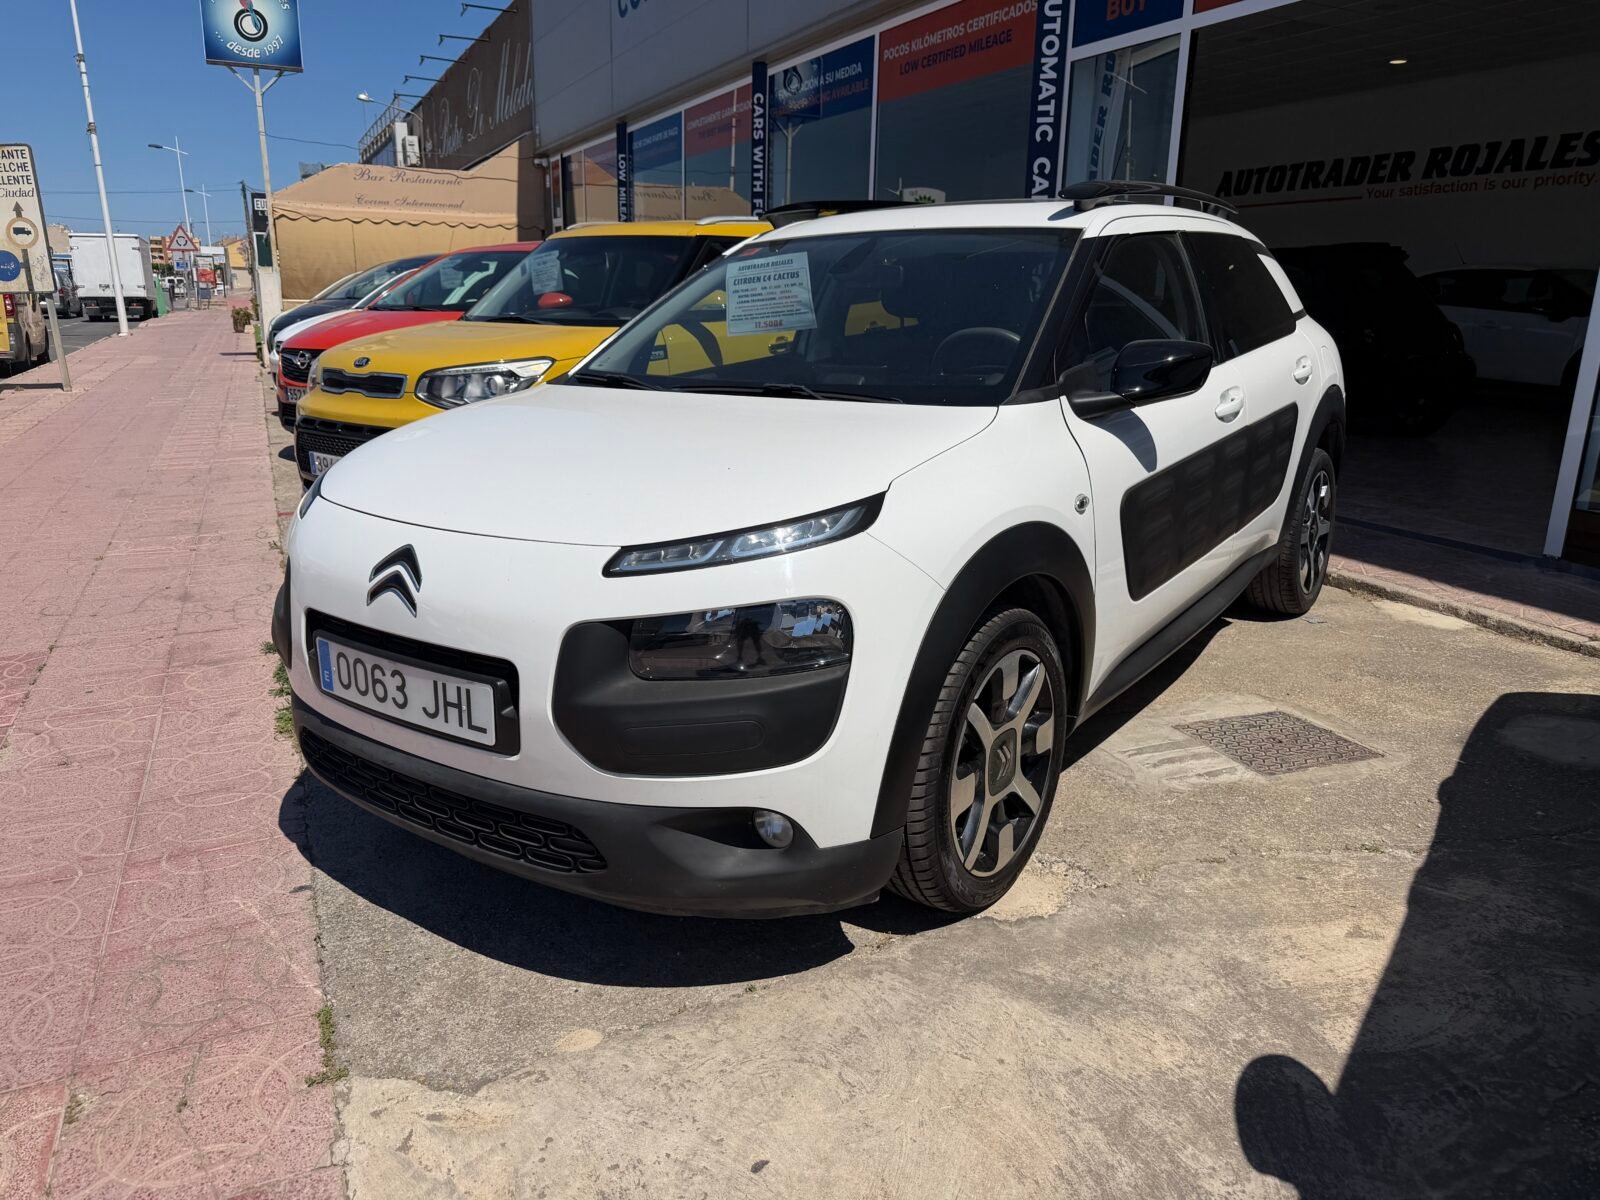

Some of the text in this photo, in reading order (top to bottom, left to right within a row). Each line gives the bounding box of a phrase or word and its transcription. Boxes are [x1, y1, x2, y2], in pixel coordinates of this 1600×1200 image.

[883, 1, 1038, 62] POCOS KILÓMETROS CERTIFICADOS
[226, 40, 261, 58] desde
[264, 34, 284, 56] 1997
[900, 29, 1013, 75] LOW CERTIFIED MILEAGE
[825, 72, 834, 83] SU
[835, 62, 862, 80] MEDIDA
[752, 92, 764, 140] CARS
[0, 149, 27, 160] ANTE
[1215, 130, 1600, 197] AUTOTRADER ROJALES
[353, 167, 463, 185] Bar Restaurante
[618, 153, 626, 182] LOW
[752, 145, 764, 192] WITH
[1031, 156, 1051, 200] CA
[0, 175, 32, 185] LENTE
[1365, 186, 1395, 200] Your
[1399, 179, 1478, 197] satisfaction
[1483, 177, 1496, 191] is
[1501, 175, 1528, 190] our
[0, 188, 34, 198] Ciudad
[354, 193, 465, 209] Cocina Internacional
[733, 271, 800, 286] CITROEN C4 CACTUS
[324, 670, 330, 682] E
[336, 651, 488, 734] 0063 JHL
